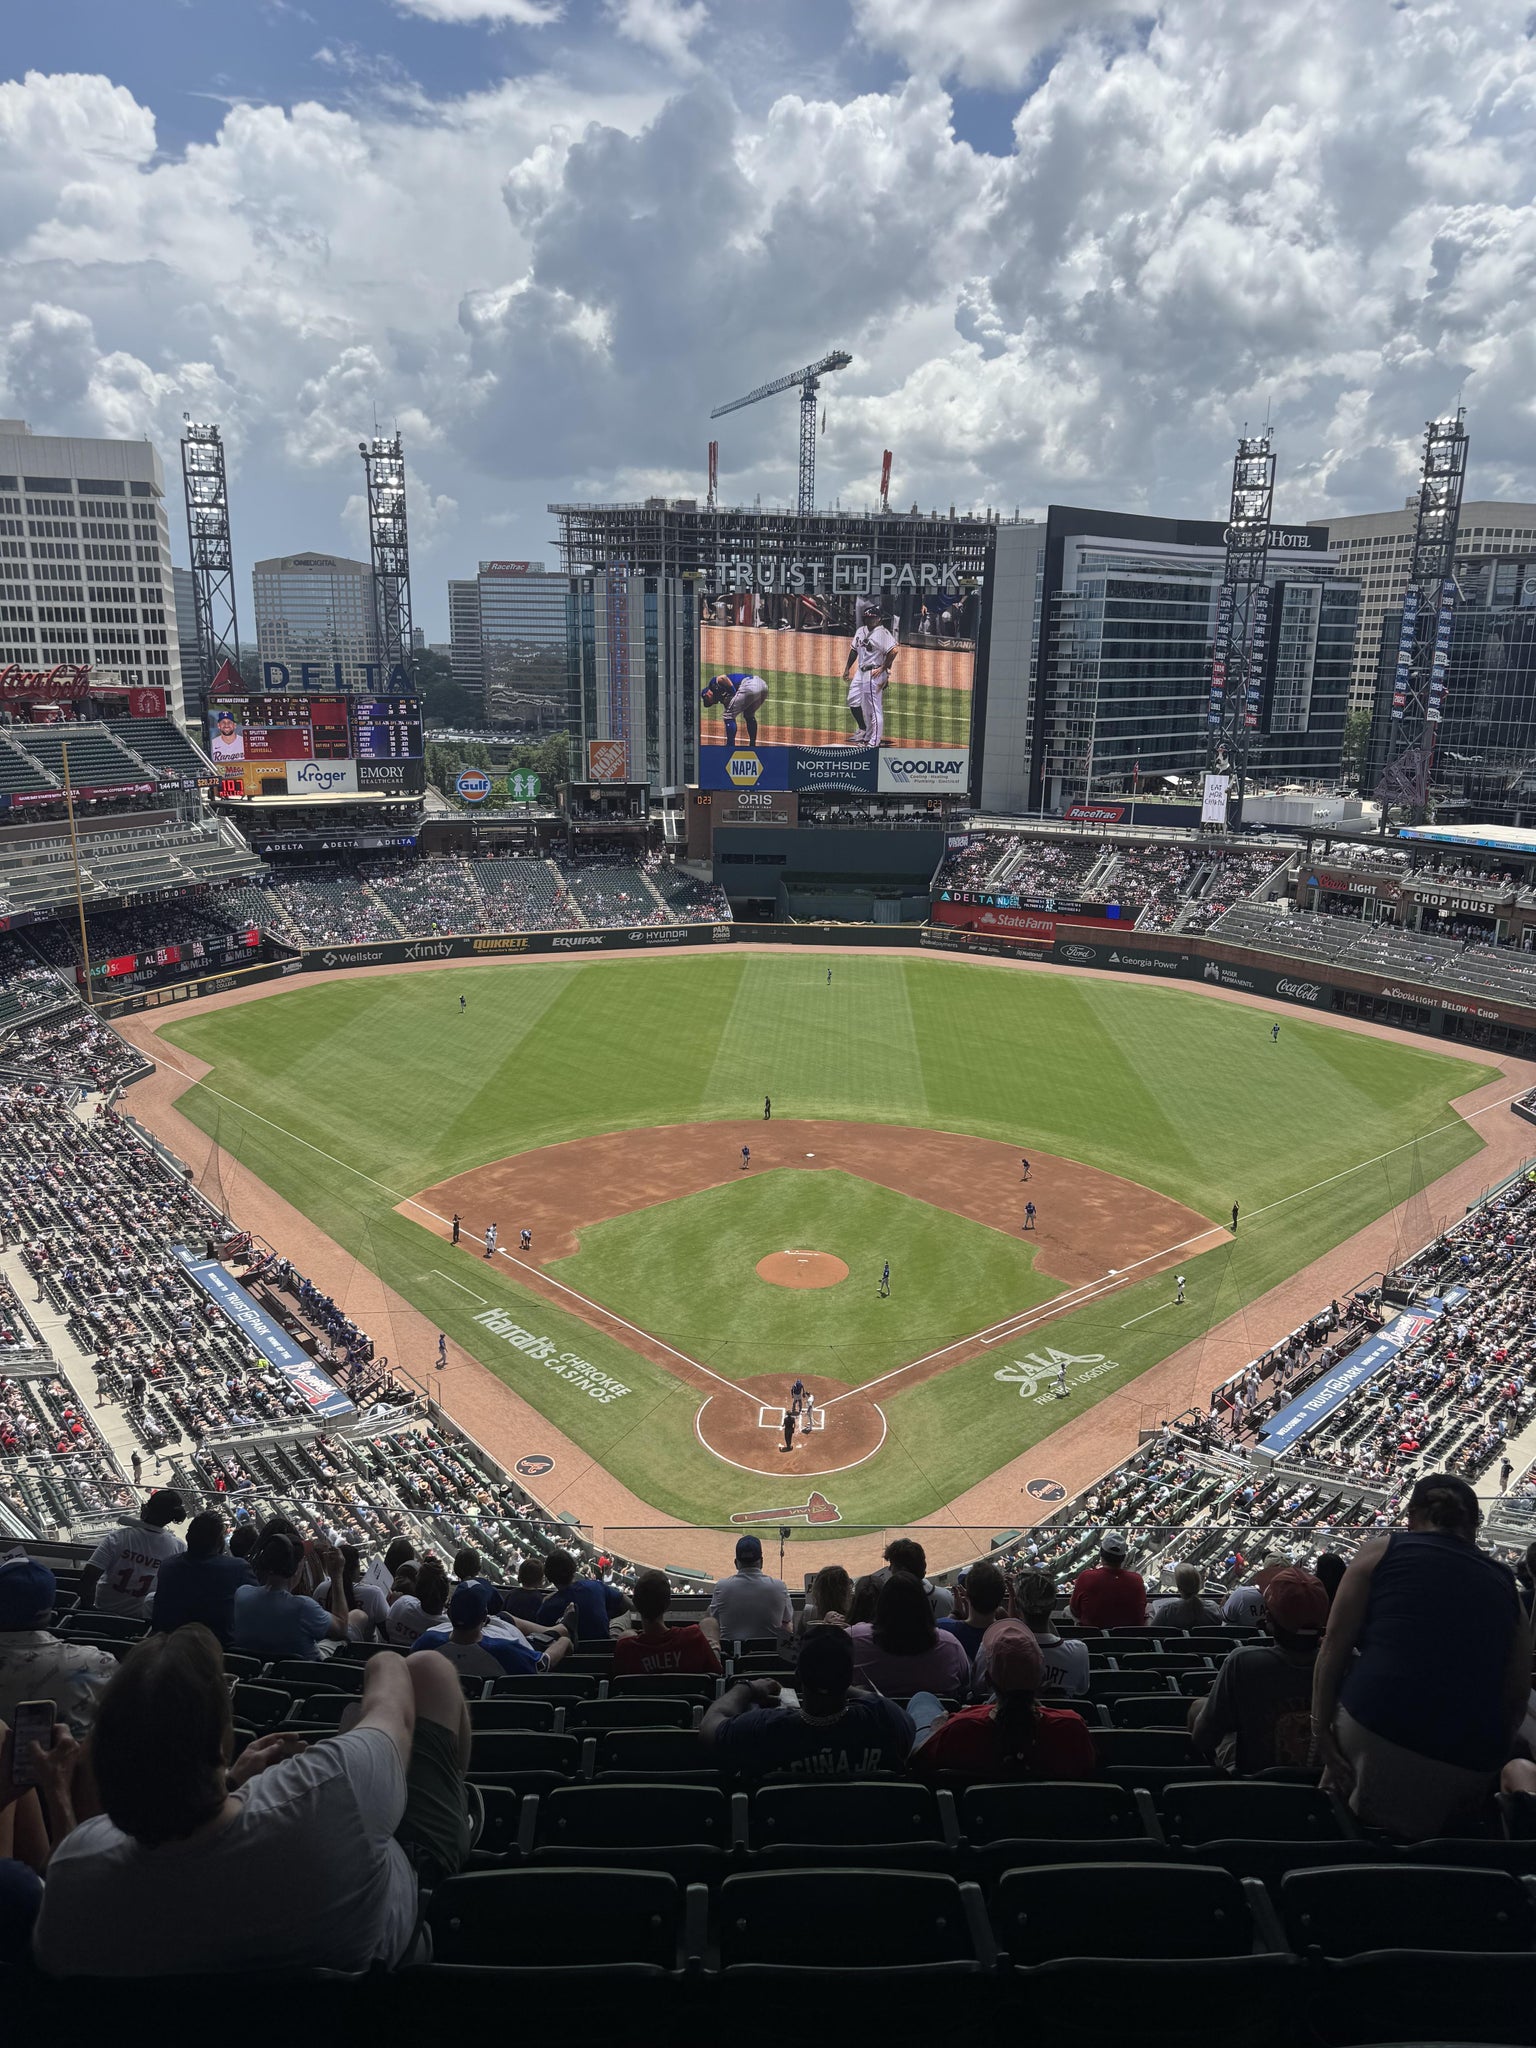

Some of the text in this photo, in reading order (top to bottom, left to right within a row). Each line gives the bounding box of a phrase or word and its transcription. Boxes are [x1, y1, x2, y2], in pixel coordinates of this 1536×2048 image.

[293, 559, 337, 568] ONEDIGITAL
[491, 562, 525, 571] RaceTrac
[714, 561, 962, 588] TRUIST PARK
[1444, 582, 1455, 591] 1997
[1257, 600, 1268, 608] 1875
[1406, 598, 1417, 606] 1998
[1442, 597, 1454, 605] 1999
[1219, 613, 1230, 621] 1877
[1404, 612, 1416, 620] 2000
[1440, 611, 1452, 620] 2001
[1402, 626, 1414, 634] 2002
[1439, 625, 1451, 634] 2003
[1400, 640, 1412, 648] 2004
[1437, 640, 1449, 648] 2005
[1399, 653, 1410, 662] 2010
[1435, 654, 1447, 662] 2012
[263, 661, 418, 690] DELTA
[1397, 668, 1409, 676] 2013
[0, 663, 93, 700] Coca-Cola
[1431, 682, 1443, 691] 2020
[1393, 695, 1405, 704] 2021
[1430, 697, 1441, 706] 2022
[1392, 710, 1404, 719] 2023
[1428, 709, 1439, 720] 2024
[593, 745, 608, 760] THE
[590, 742, 626, 778] HOME
[796, 760, 871, 771] NORTHSIDE
[359, 766, 405, 779] EMORY
[604, 757, 626, 778] DEPOT
[732, 760, 758, 776] NAPA
[890, 760, 964, 774] COOLRAY
[297, 763, 347, 790] Kroger
[809, 771, 857, 779] HOSPITAL
[159, 782, 170, 791] 1:44
[170, 781, 180, 789] PM
[458, 779, 489, 791] Gulf
[62, 790, 81, 798] CSTA
[738, 794, 772, 805] ORIS
[1208, 791, 1223, 799] MOR
[1069, 807, 1117, 820] RaceTrac
[76, 831, 139, 855] AARON
[128, 823, 205, 850] TERRACE
[275, 843, 304, 851] DELTA
[385, 838, 412, 846] DELTA
[1318, 875, 1378, 895] Coors LIGHT
[953, 892, 994, 905] DELTA
[1413, 892, 1495, 914] CHOP HOUSE
[646, 930, 688, 939] HYUNDAI
[712, 925, 730, 933] PAPA
[473, 937, 529, 949] QUIKRETE
[551, 936, 603, 948] EQUIFAX
[235, 948, 257, 959] MLB+
[404, 941, 454, 960] xfinity
[1066, 945, 1090, 958] Ford
[189, 956, 213, 968] MLB+
[338, 951, 383, 963] Wellstar
[1121, 955, 1178, 970] Georgia Power
[133, 969, 158, 982] MLB+
[1221, 969, 1238, 978] KAISER
[1275, 978, 1321, 1001] Coca-Cola
[1391, 987, 1499, 1020] Coors LIGHT BELOW CHOP
[224, 1291, 272, 1336] TRUIST PARK
[472, 1307, 558, 1360] Harrah's
[1376, 1313, 1416, 1348] Braves
[279, 1361, 336, 1392] Braves
[559, 1352, 632, 1397] CHEROKEE
[1076, 1360, 1120, 1384] LOGISTICS
[543, 1358, 616, 1404] CASINOS
[1303, 1365, 1365, 1412] TRUIST PARK
[640, 1650, 682, 1673] RILEY
